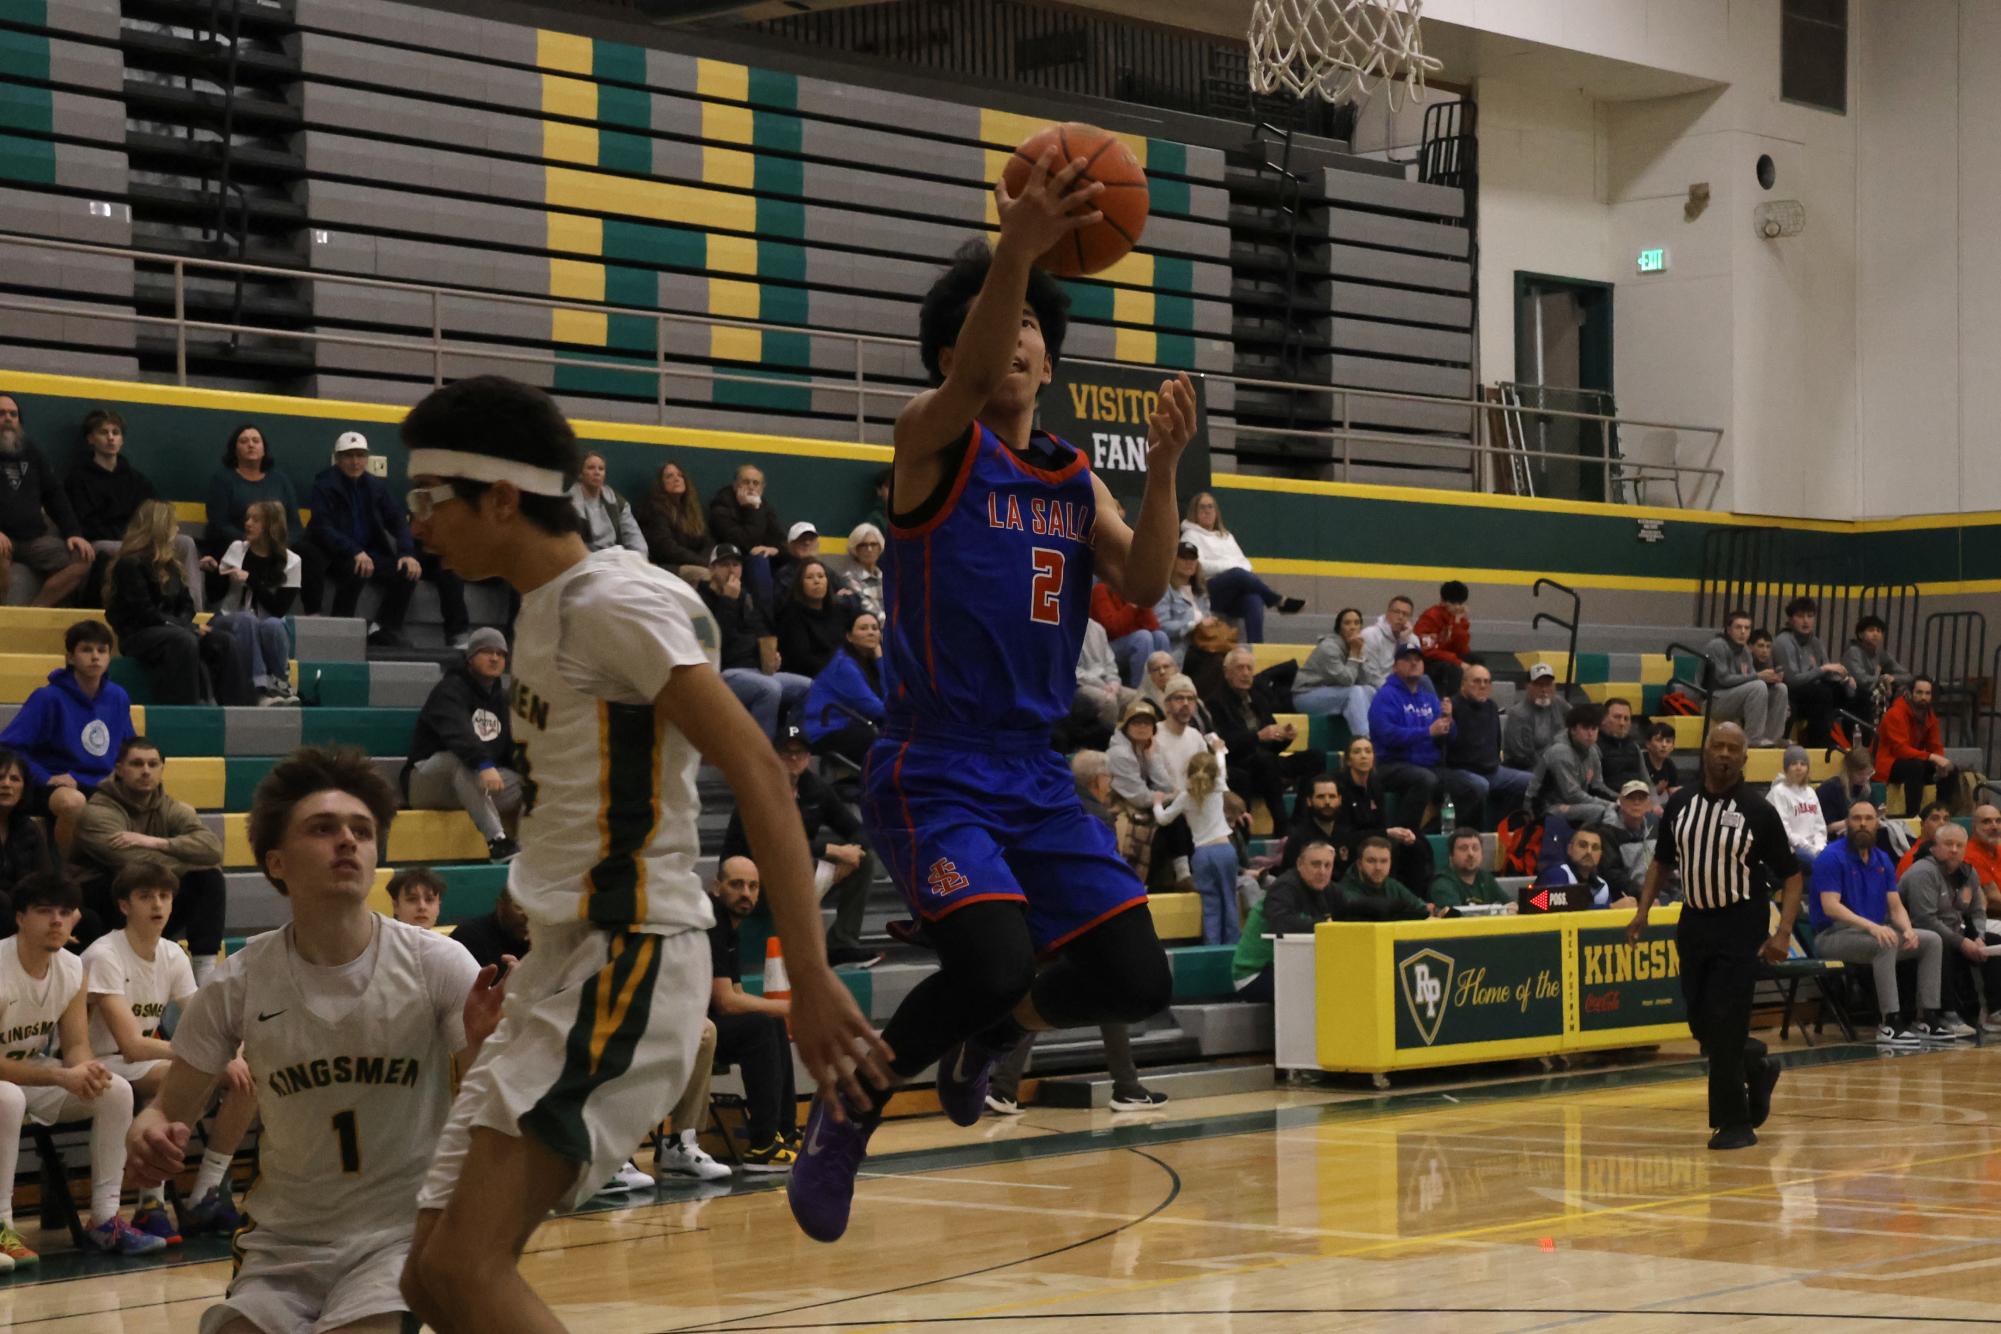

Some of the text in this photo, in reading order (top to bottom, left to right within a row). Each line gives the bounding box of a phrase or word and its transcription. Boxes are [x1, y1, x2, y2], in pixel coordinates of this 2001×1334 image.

[1641, 249, 1663, 270] EXIT
[1092, 432, 1149, 472] FAN
[988, 491, 1024, 531] LA
[1030, 546, 1066, 626] 2
[789, 726, 799, 737] P
[1455, 967, 1560, 1013] Home of the
[268, 1056, 419, 1097] KINGSMEN
[332, 1110, 361, 1174] 1
